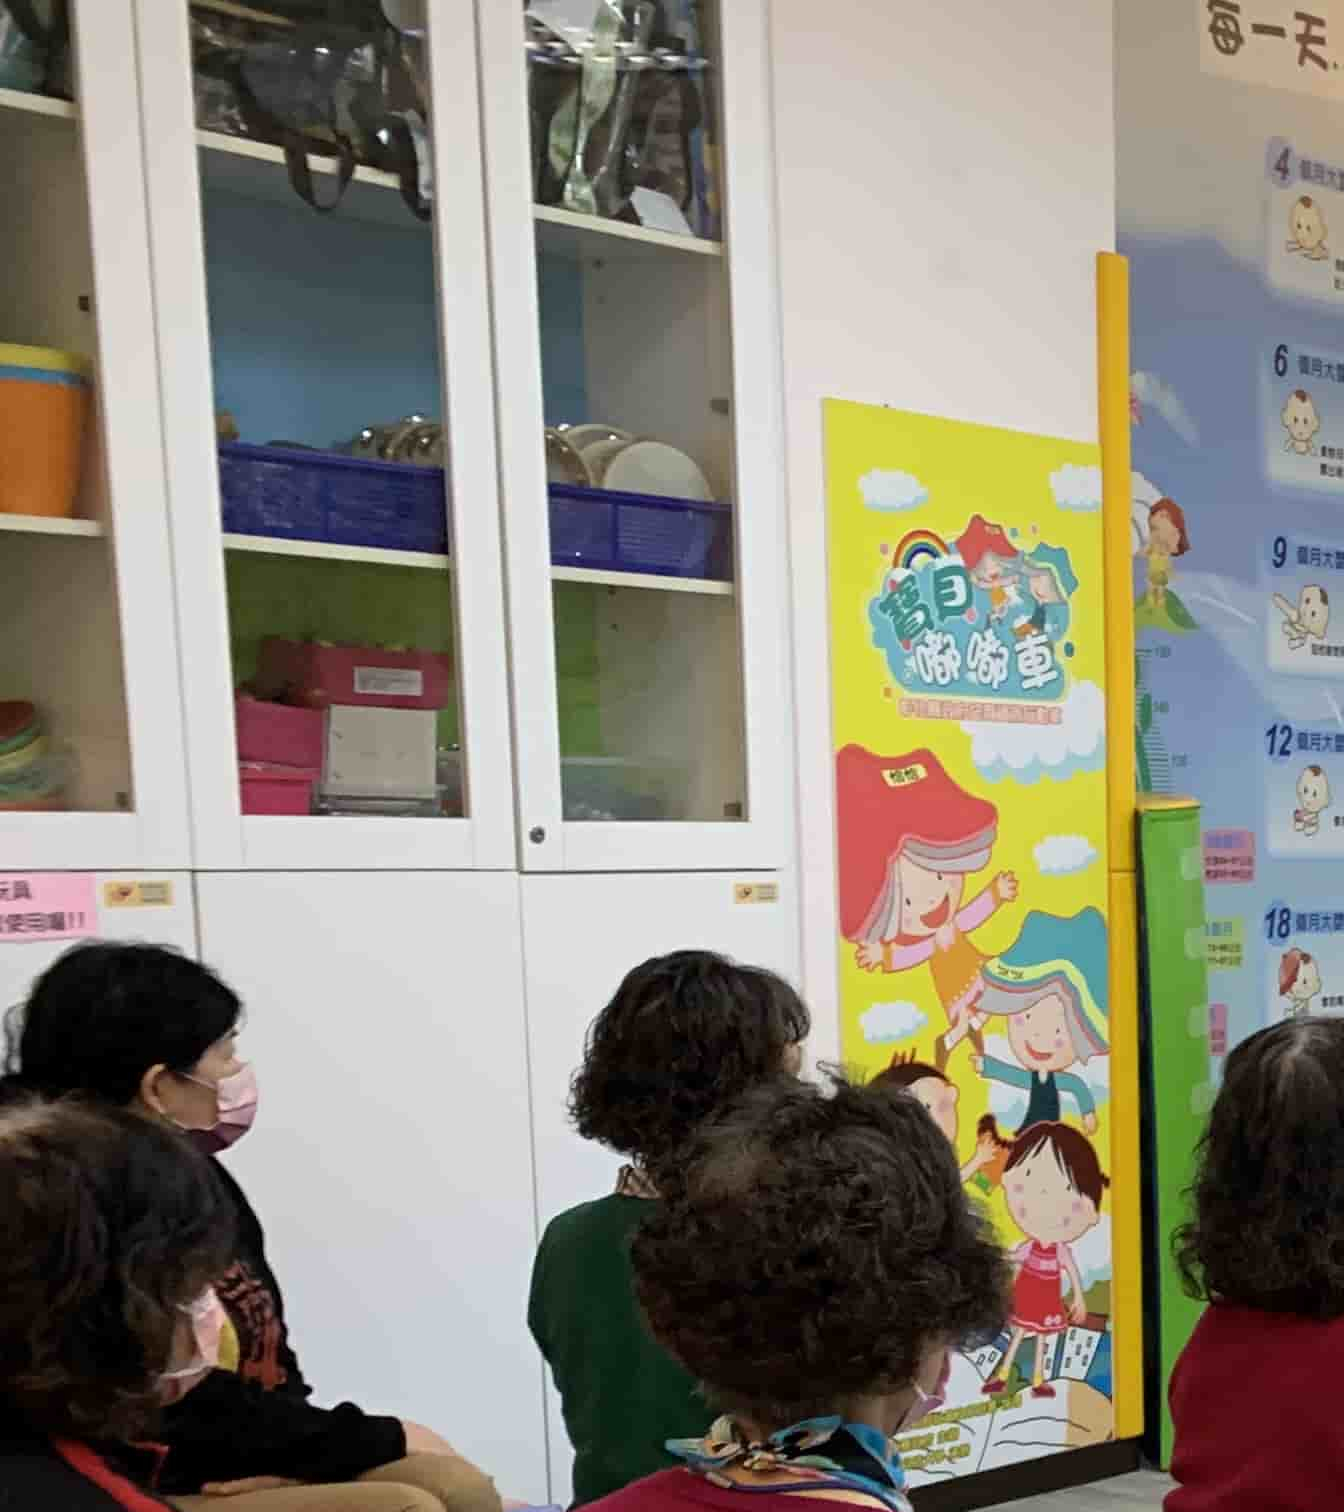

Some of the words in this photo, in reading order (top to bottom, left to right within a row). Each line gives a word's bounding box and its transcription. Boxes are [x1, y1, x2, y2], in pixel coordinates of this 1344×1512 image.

[1274, 147, 1291, 182] 4
[1274, 343, 1290, 378] 6
[1271, 535, 1288, 569] 9
[1265, 723, 1293, 757] 12
[1264, 907, 1292, 940] 18
